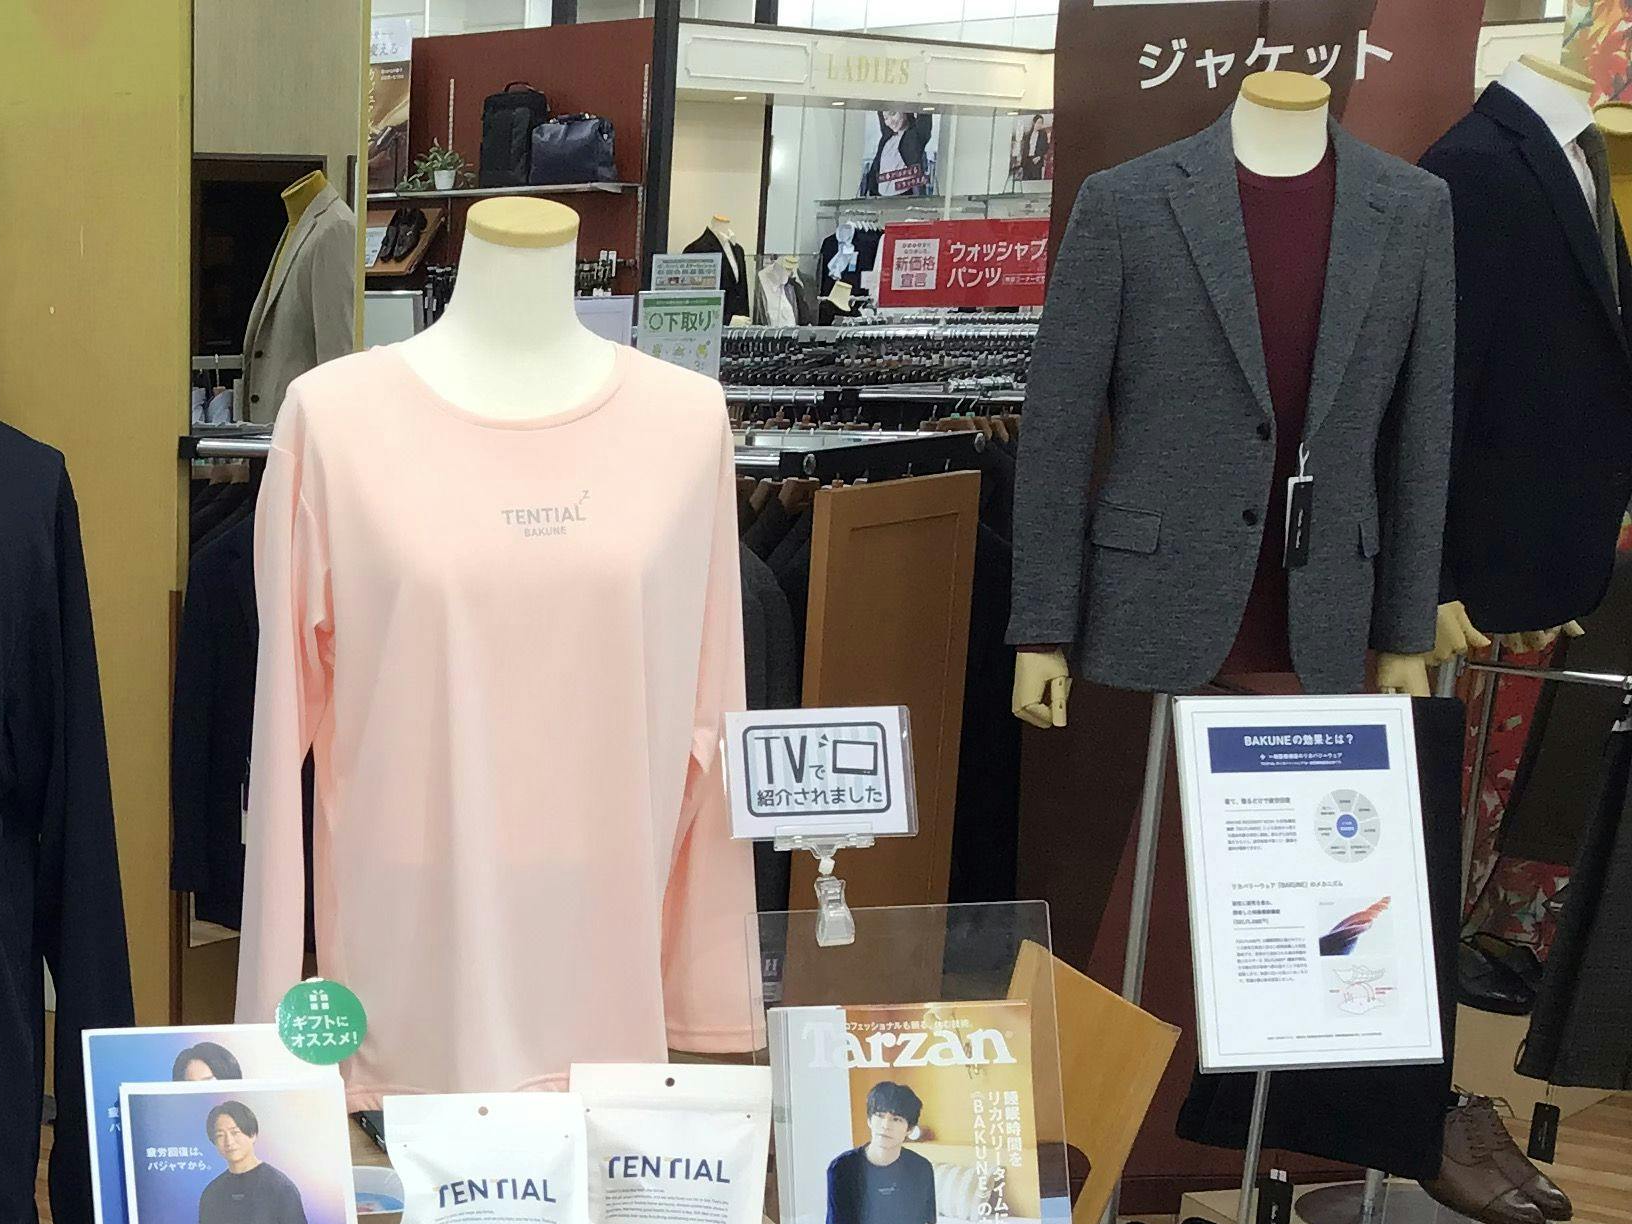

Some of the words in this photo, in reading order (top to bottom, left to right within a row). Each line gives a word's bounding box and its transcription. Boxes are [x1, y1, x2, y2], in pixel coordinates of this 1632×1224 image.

[827, 54, 910, 85] LADIES
[1138, 29, 1393, 89] ジャケット
[947, 267, 1003, 289] パンツ
[501, 505, 586, 525] TENTIAL
[524, 526, 567, 538] BAKUNE
[756, 785, 883, 807] 紹介されました
[292, 1015, 349, 1031] ギフトに
[801, 1021, 1018, 1069] Tarzan
[603, 1155, 731, 1184] TENTIAL
[433, 1178, 557, 1208] TENTIAL
